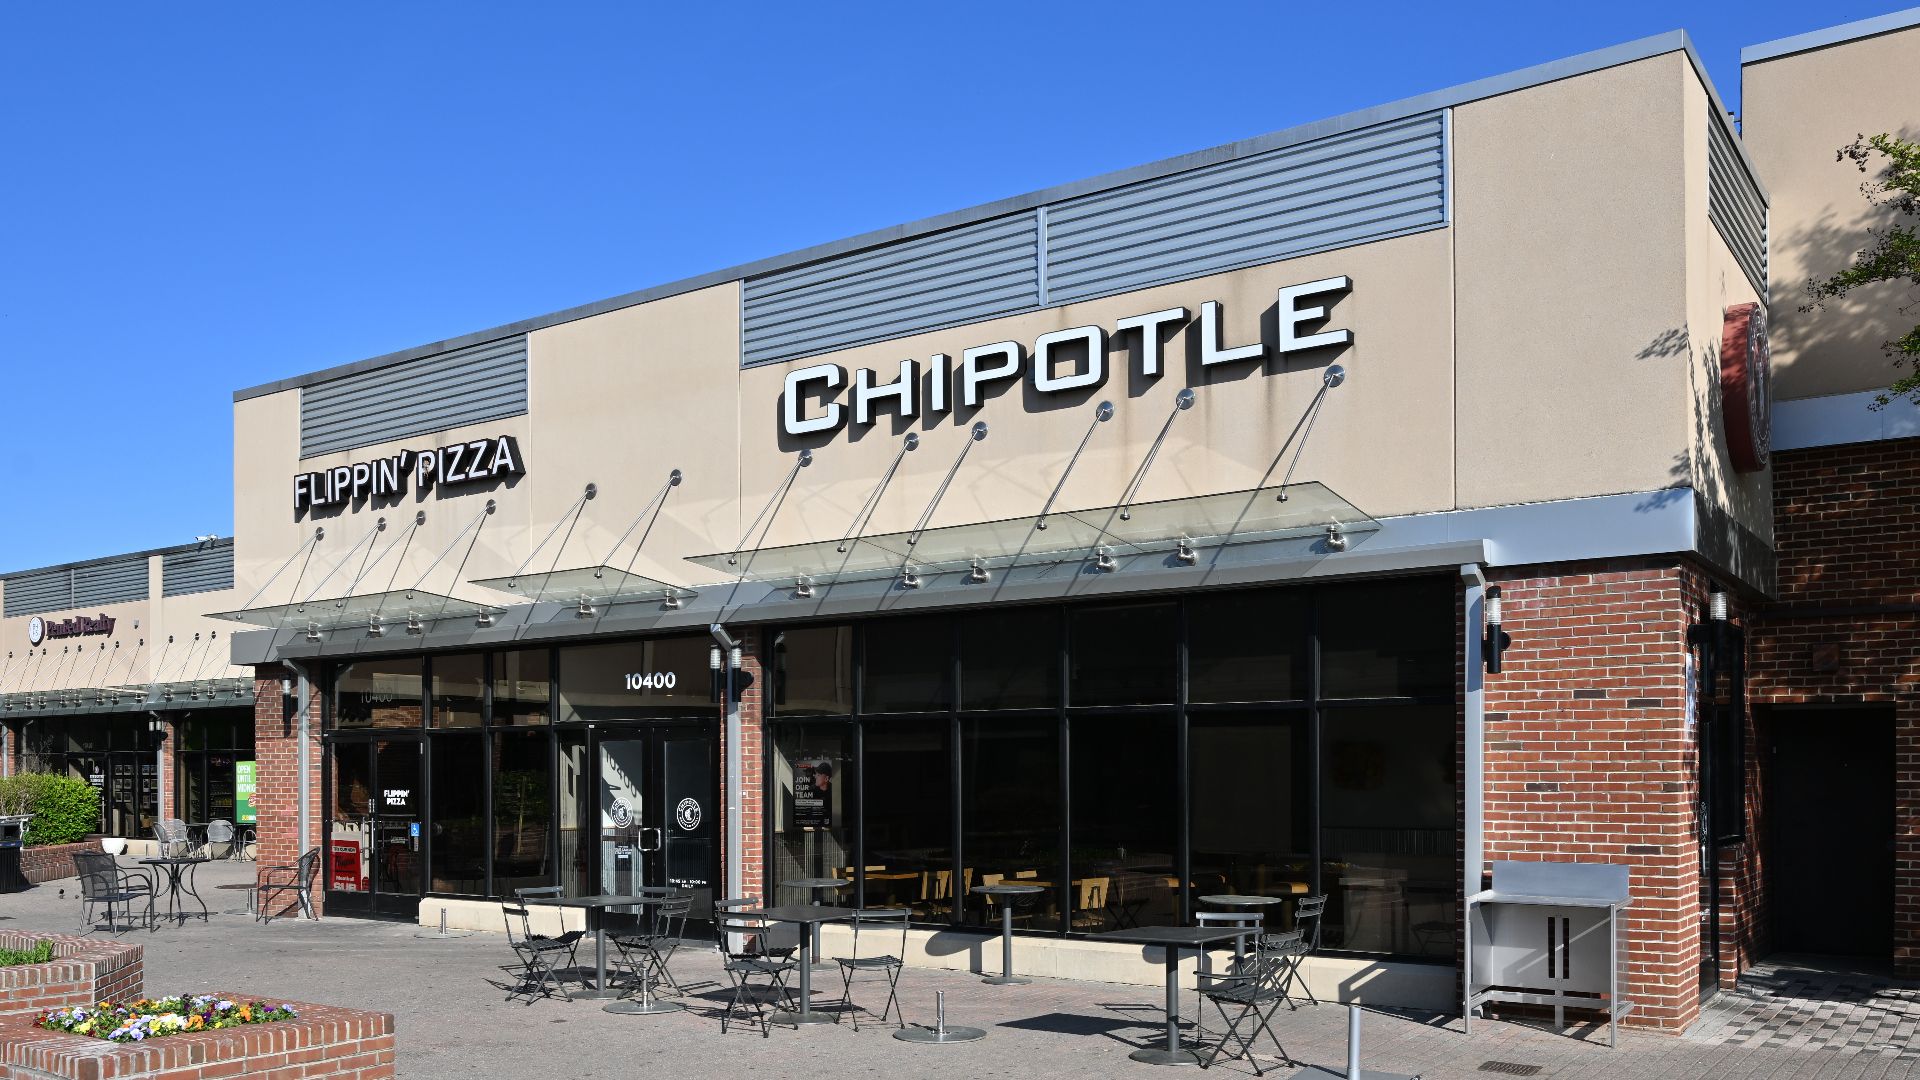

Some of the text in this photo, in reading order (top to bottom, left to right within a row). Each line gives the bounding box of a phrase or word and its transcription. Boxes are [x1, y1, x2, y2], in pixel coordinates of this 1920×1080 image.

[784, 275, 1353, 435] CHIPOTLE
[293, 434, 520, 509] FLIPPIN' PIZZA
[46, 616, 82, 638] PenFed
[81, 613, 116, 638] Realty
[625, 671, 676, 690] 10400
[237, 765, 251, 773] OPEN
[237, 774, 251, 783] UNTIL
[237, 783, 256, 793] MIDNIG
[383, 789, 410, 798] FLIPPIN'
[795, 791, 814, 799] TEAM
[386, 797, 406, 806] PIZZA
